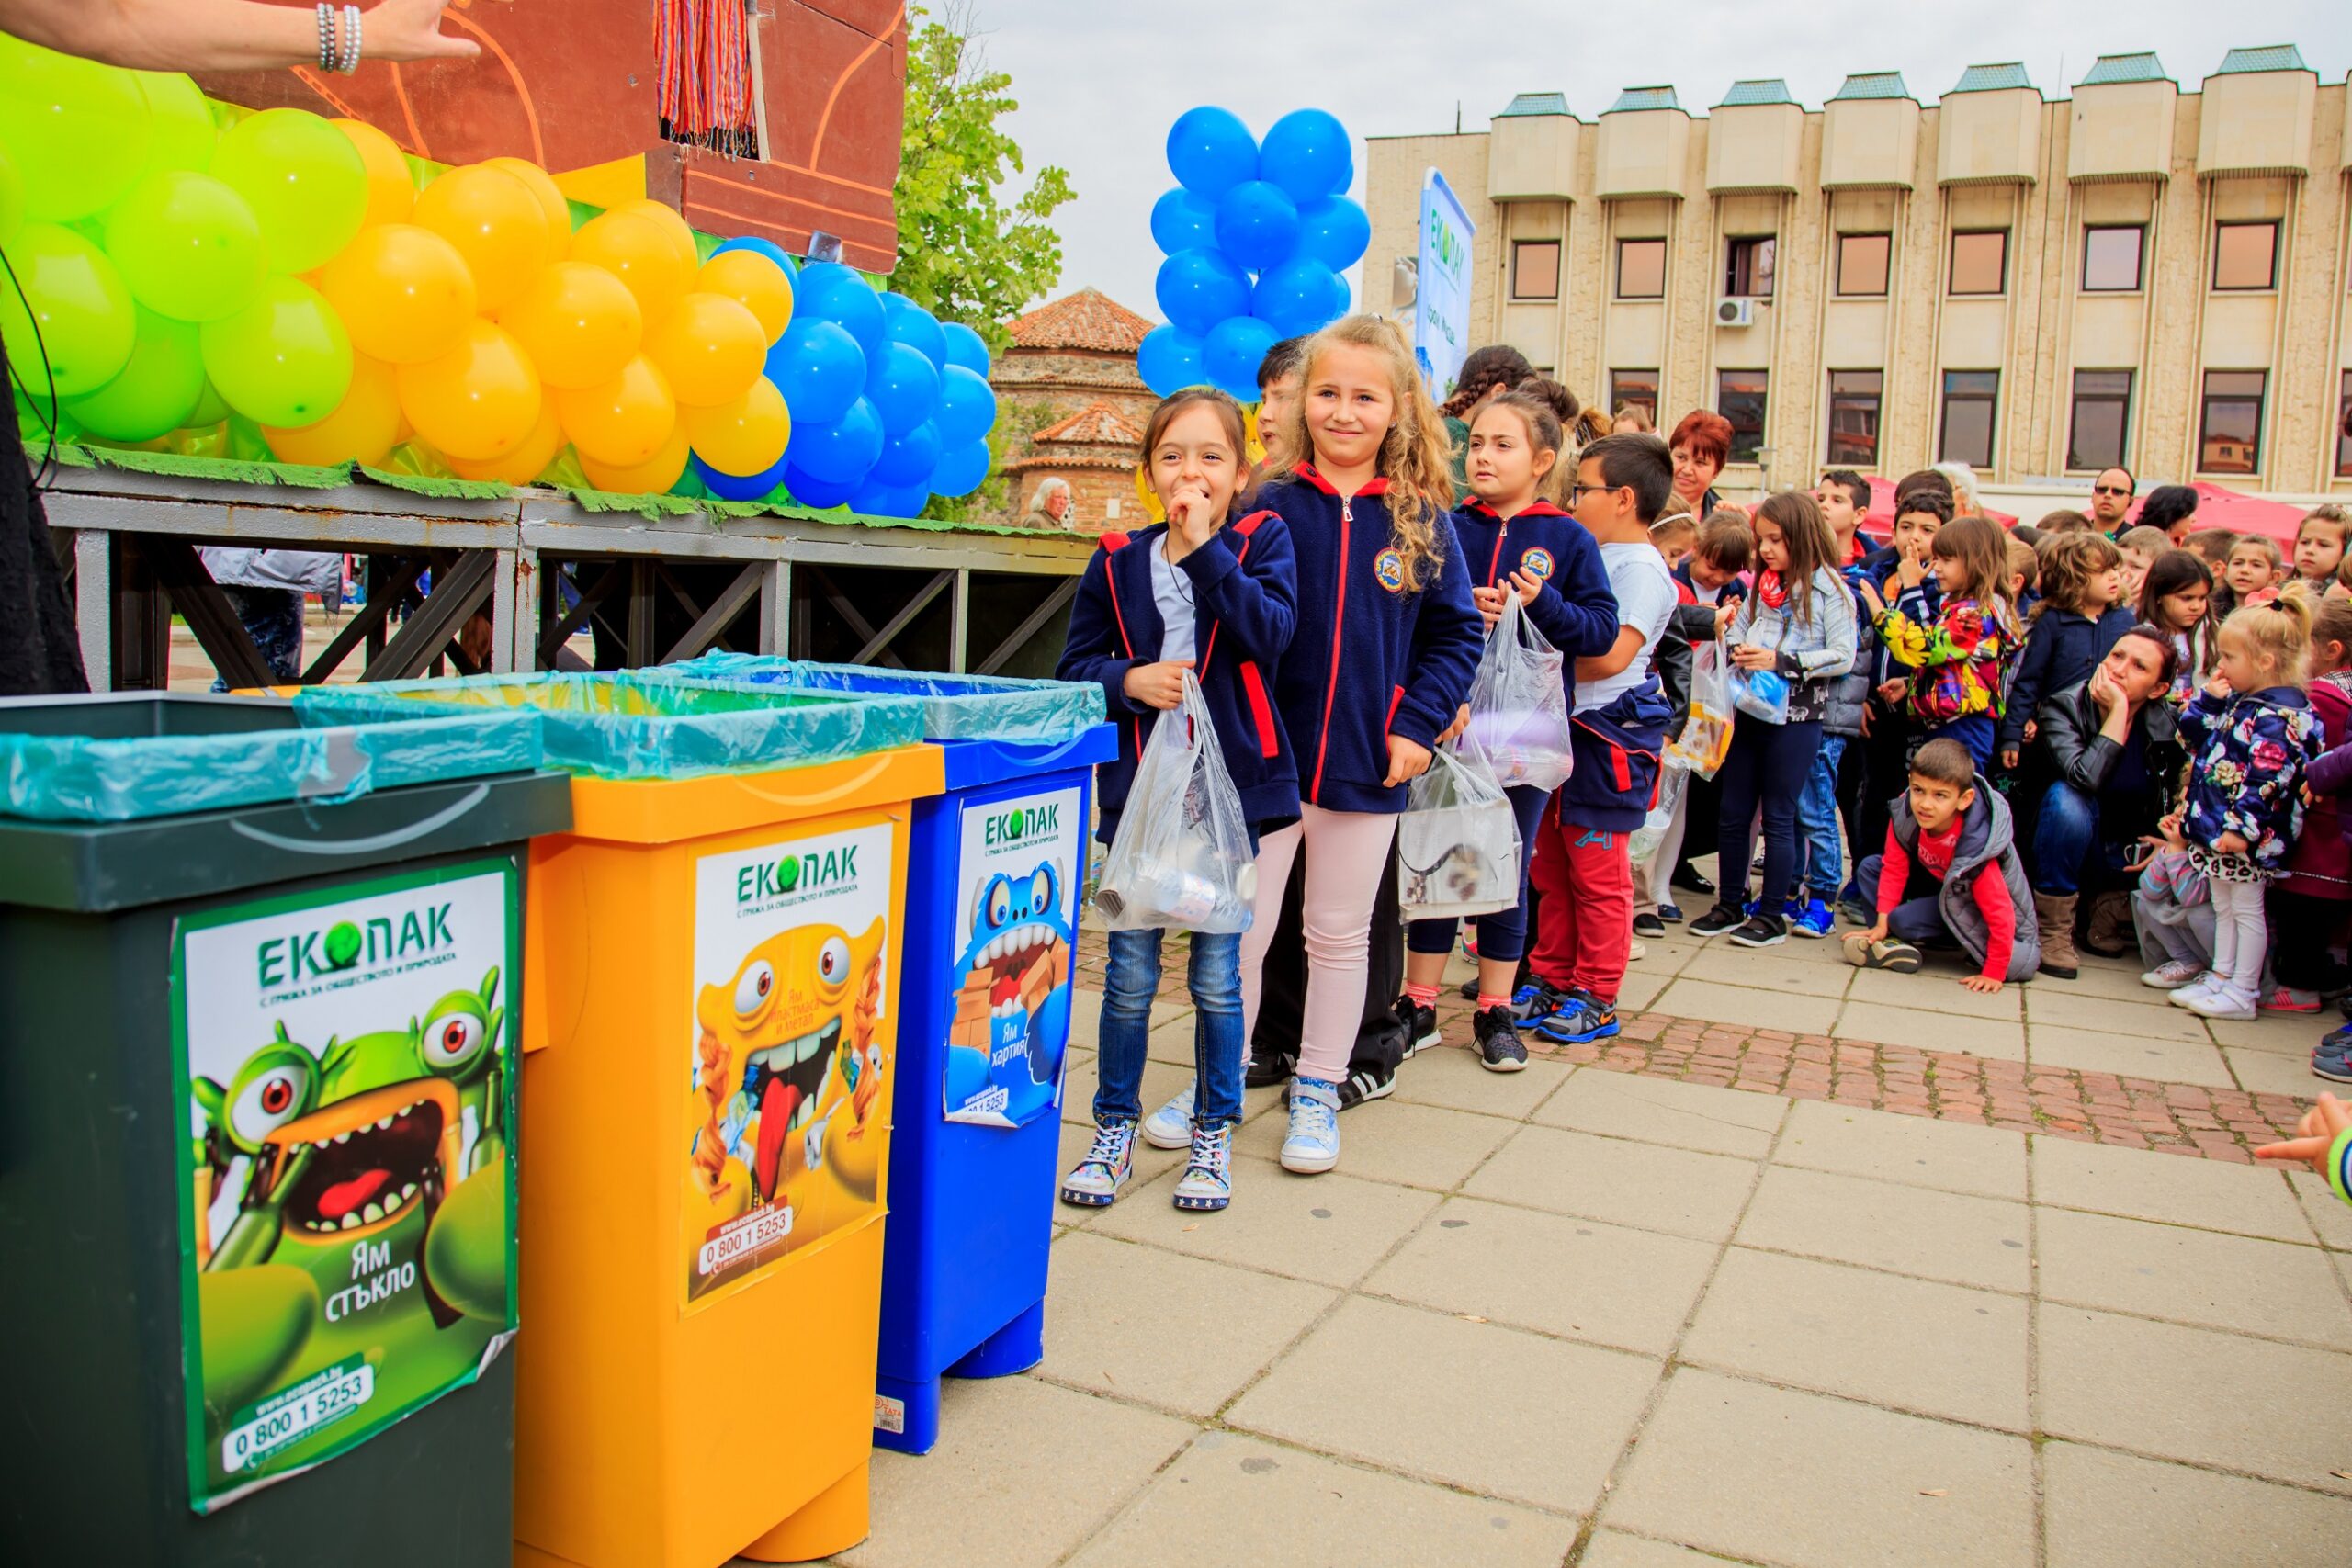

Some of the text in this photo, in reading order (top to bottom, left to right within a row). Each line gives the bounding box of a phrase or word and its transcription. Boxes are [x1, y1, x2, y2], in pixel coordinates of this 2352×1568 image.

[1430, 209, 1464, 288] ЕКОПАК
[985, 803, 1059, 845] ЕКОПАК
[738, 844, 858, 903] ЕКОПАК
[742, 906, 765, 917] ГРИЖА
[766, 903, 775, 912] ЗА
[824, 884, 858, 897] ПРИРОДАТА
[256, 902, 454, 987] ЕКОПАК
[270, 989, 306, 1005] ГРИЖА
[311, 985, 322, 996] ЗА
[405, 953, 457, 971] ПРИРОДАТА
[991, 1038, 1025, 1067] хартия
[1002, 1022, 1018, 1043] Ям
[352, 1239, 390, 1280] Ям
[707, 1247, 715, 1263] 0
[718, 1234, 741, 1258] 800
[746, 1228, 752, 1245] 1
[757, 1213, 786, 1240] 5253
[325, 1260, 416, 1323] стъкло
[235, 1433, 248, 1456] 0
[255, 1411, 292, 1447] 800
[300, 1403, 309, 1423] 1
[317, 1376, 362, 1415] 5253
